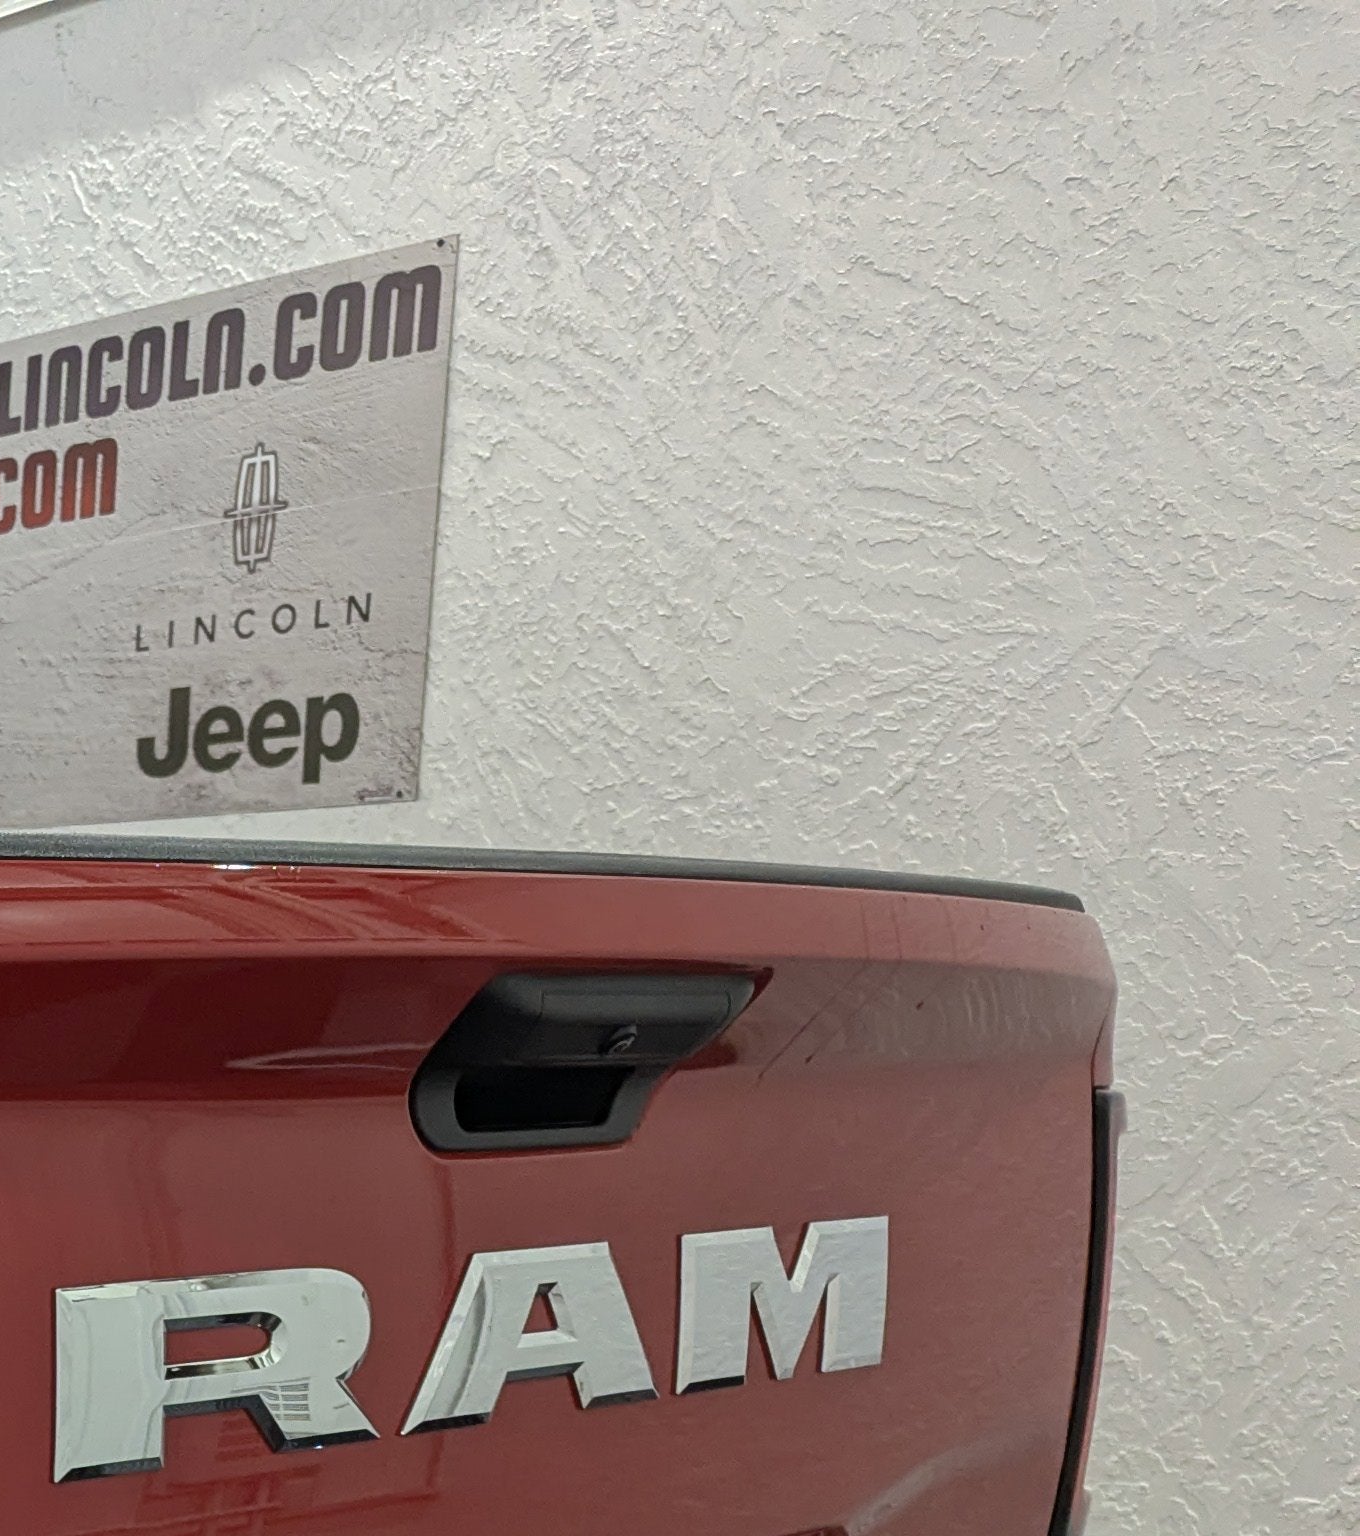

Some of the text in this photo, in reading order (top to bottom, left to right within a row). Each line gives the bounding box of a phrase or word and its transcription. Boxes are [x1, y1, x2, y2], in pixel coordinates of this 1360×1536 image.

[135, 592, 372, 651] LINCOLN
[137, 686, 359, 784] Jeep
[53, 1215, 889, 1484] RAM
